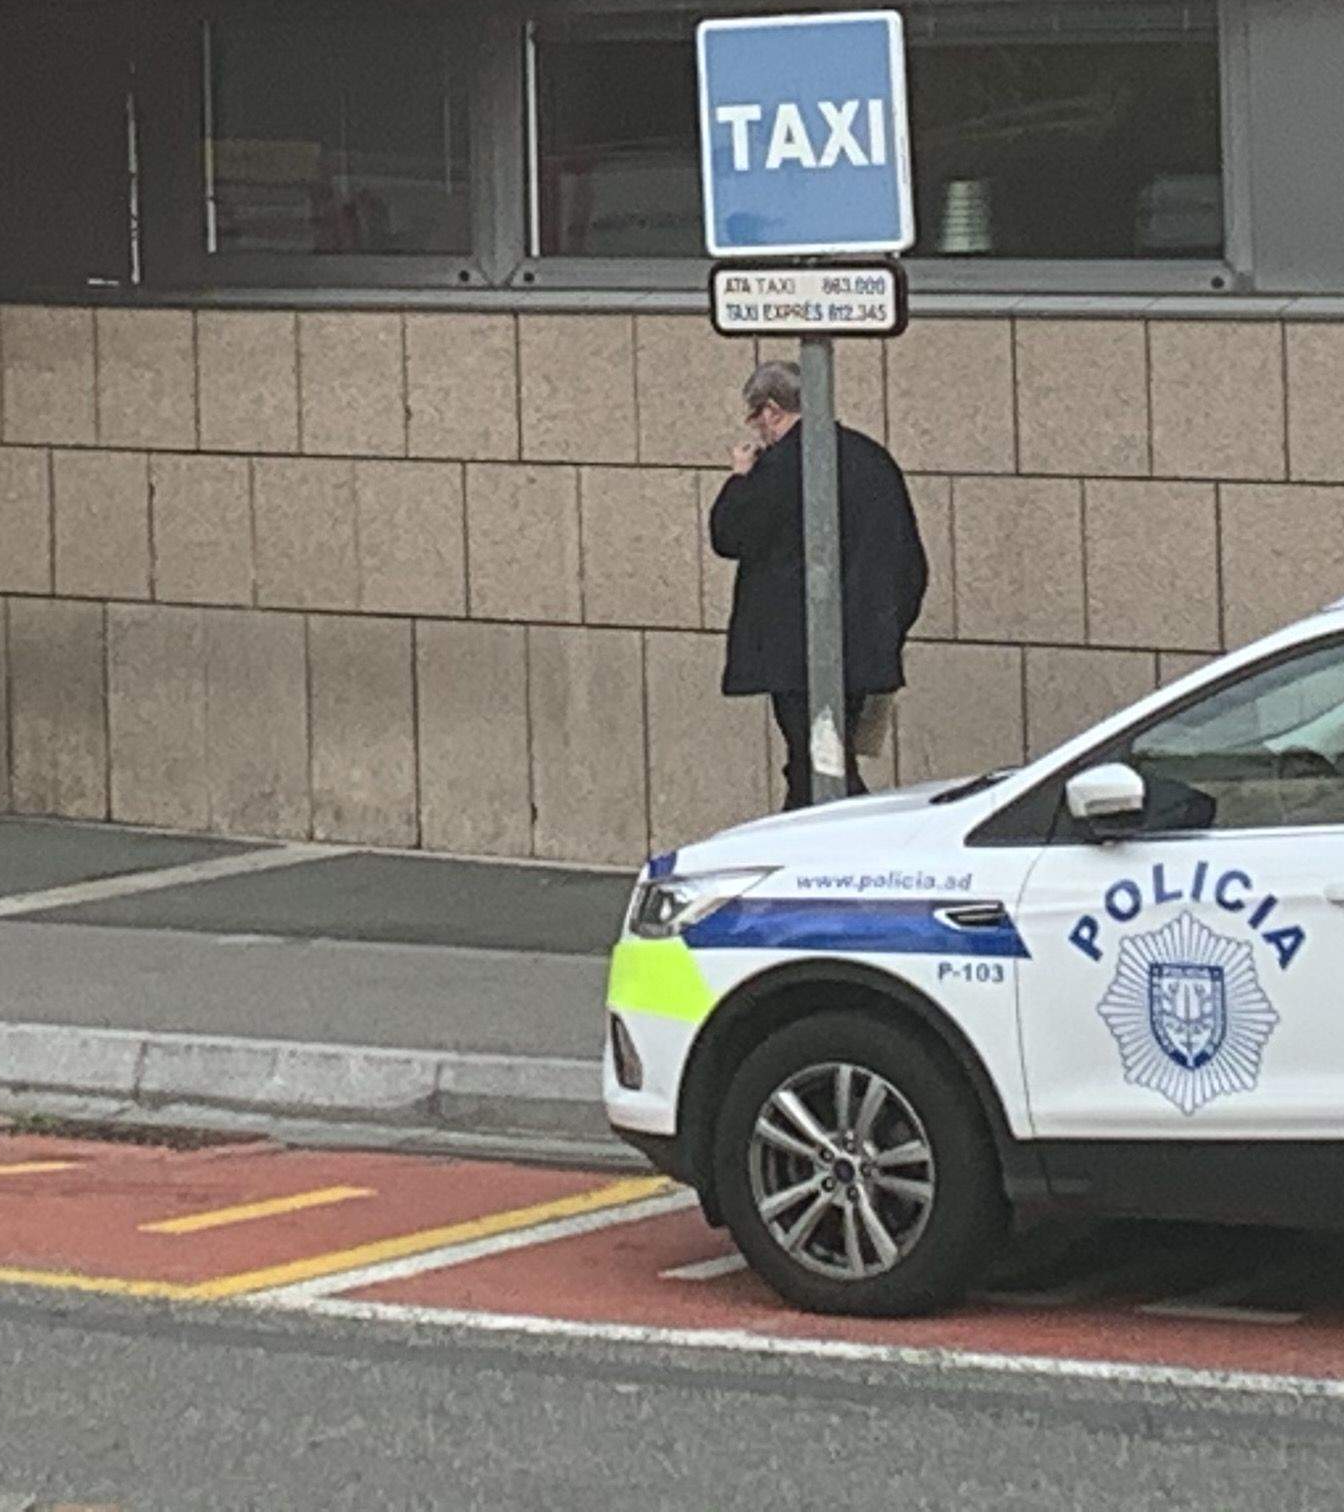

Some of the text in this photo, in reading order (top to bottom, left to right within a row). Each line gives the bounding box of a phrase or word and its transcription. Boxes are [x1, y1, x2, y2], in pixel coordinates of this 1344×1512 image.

[714, 99, 887, 172] TAXI
[756, 277, 796, 295] TAXI
[726, 304, 759, 322] TAXI
[796, 871, 973, 893] www.policia.ad
[1068, 860, 1307, 971] POLICIA
[937, 963, 1005, 983] P-103
